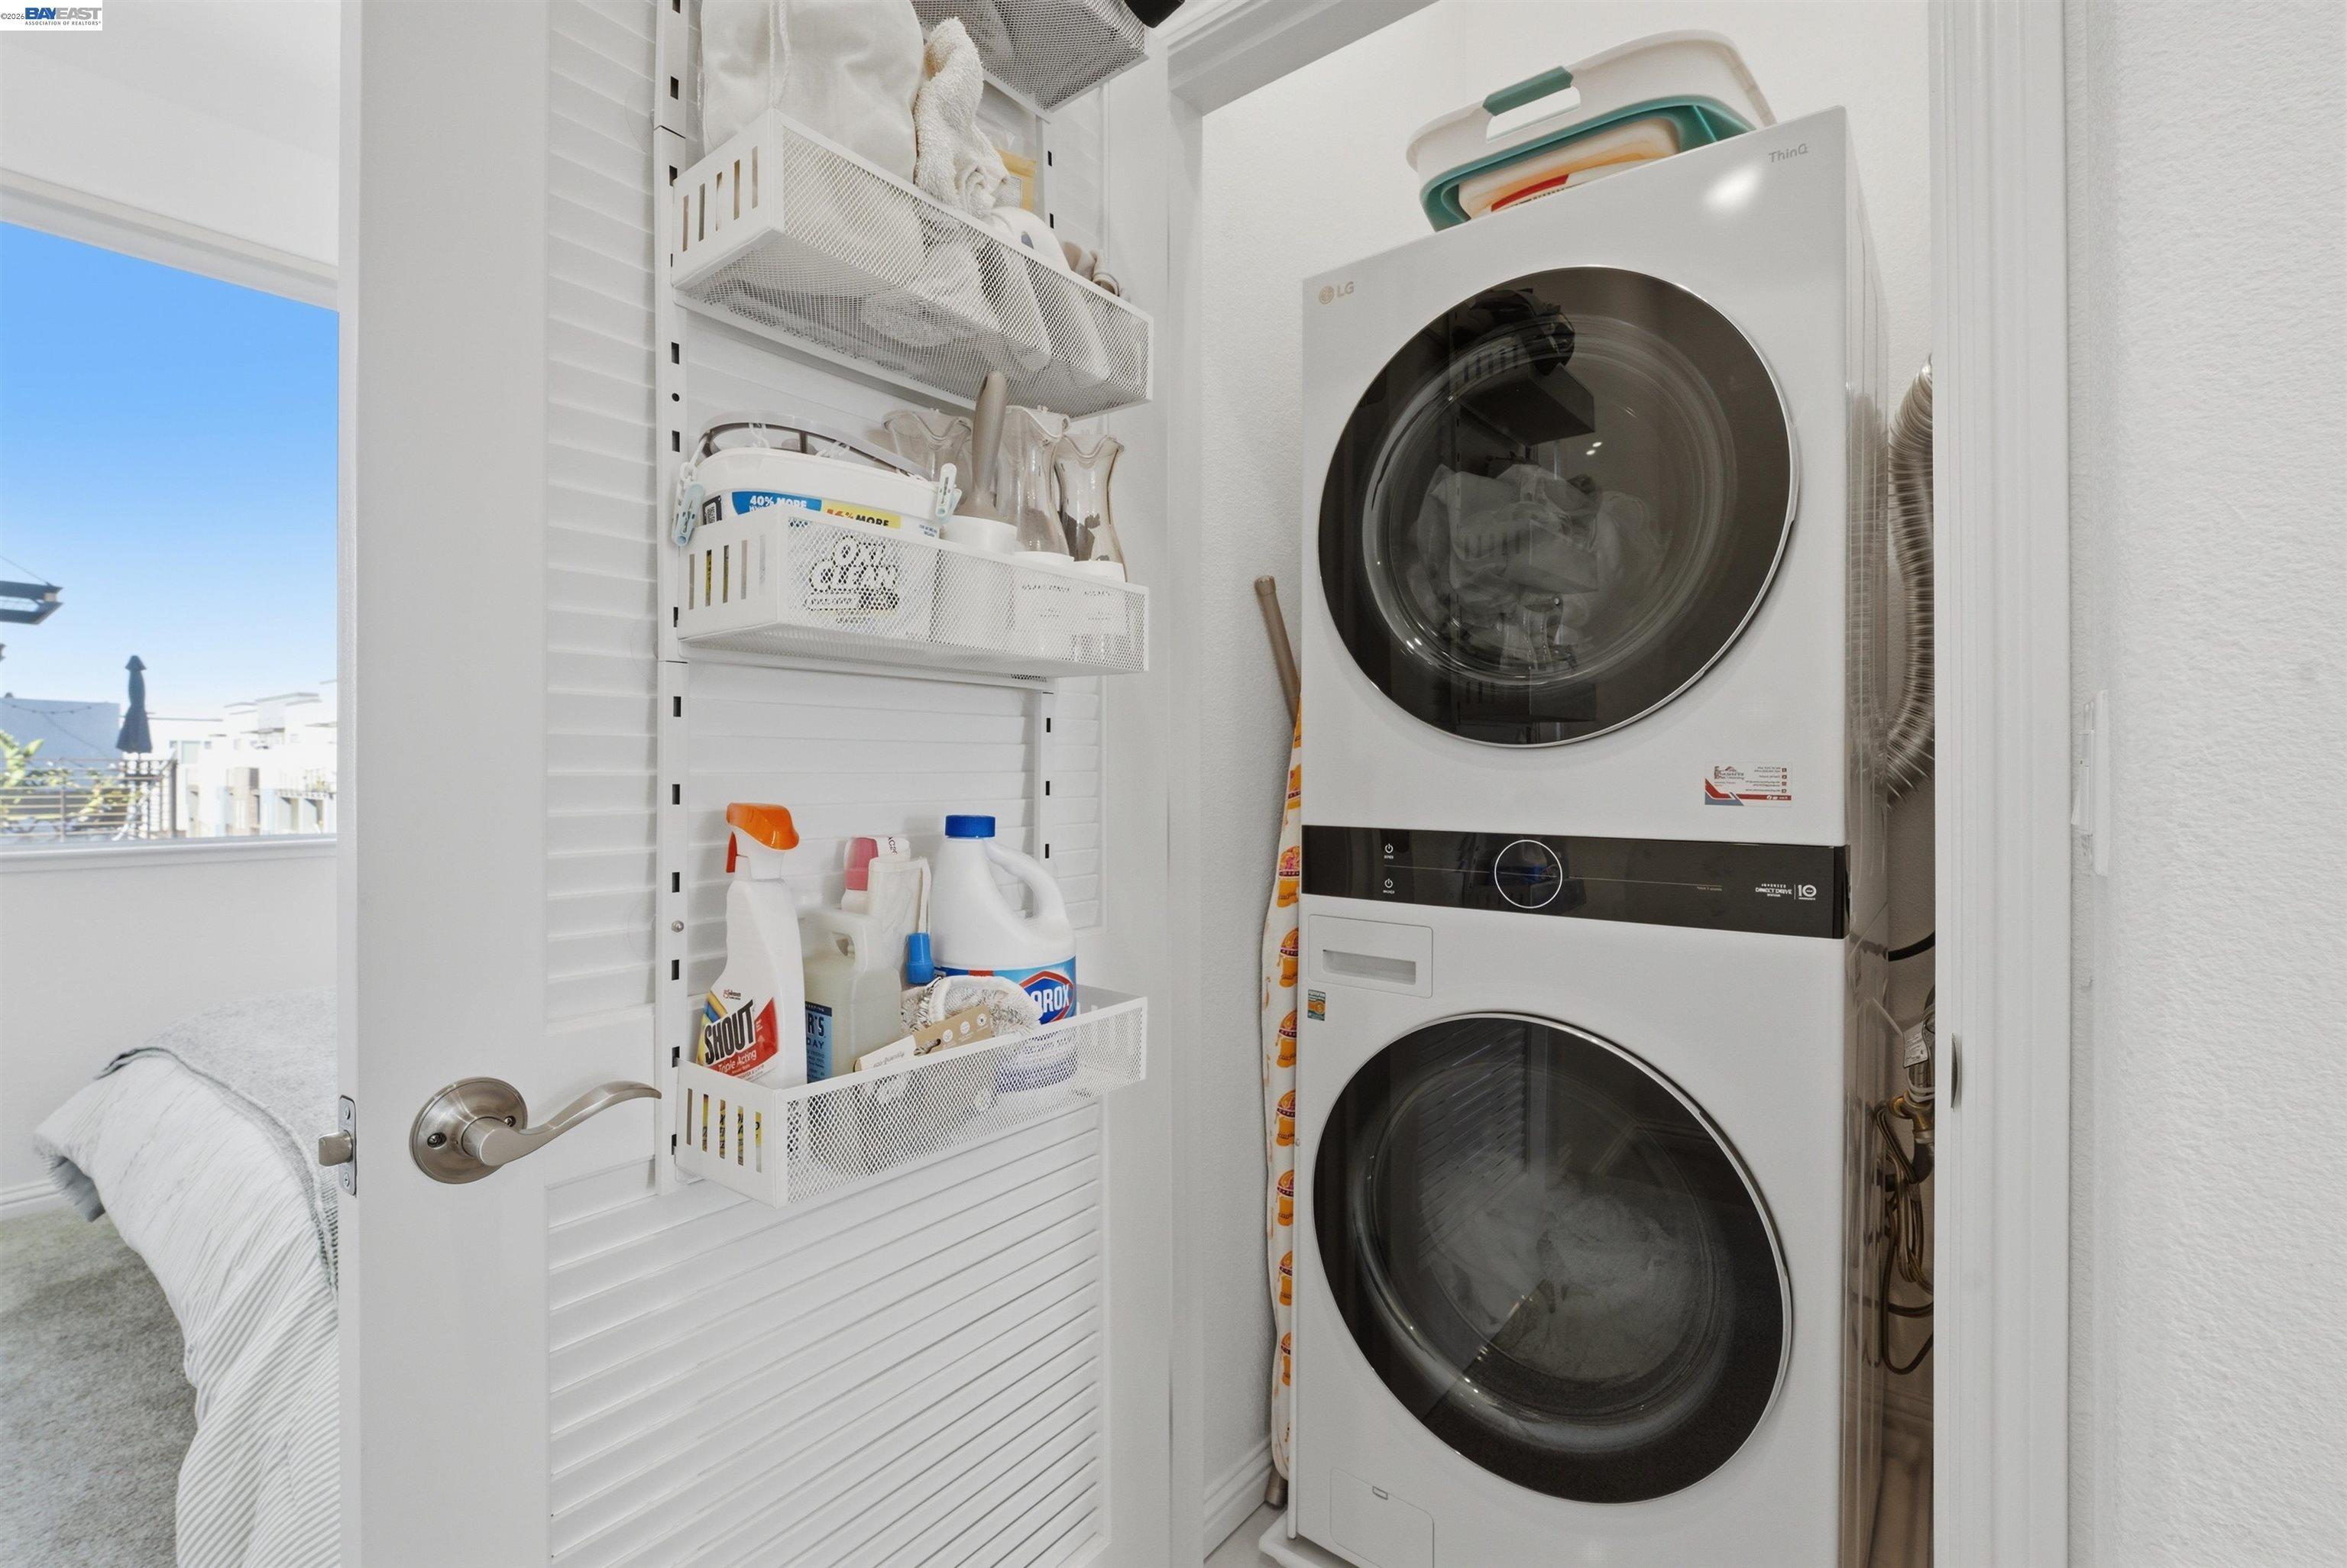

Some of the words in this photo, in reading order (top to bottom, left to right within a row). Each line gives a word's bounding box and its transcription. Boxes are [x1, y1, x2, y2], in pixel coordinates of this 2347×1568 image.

[1768, 143, 1809, 163] ThinQ
[1337, 281, 1355, 298] LG
[749, 494, 774, 506] 40%
[856, 514, 890, 527] MORE
[1031, 984, 1070, 1014] OROX
[704, 999, 755, 1065] SHOUT
[736, 1049, 757, 1065] Acting
